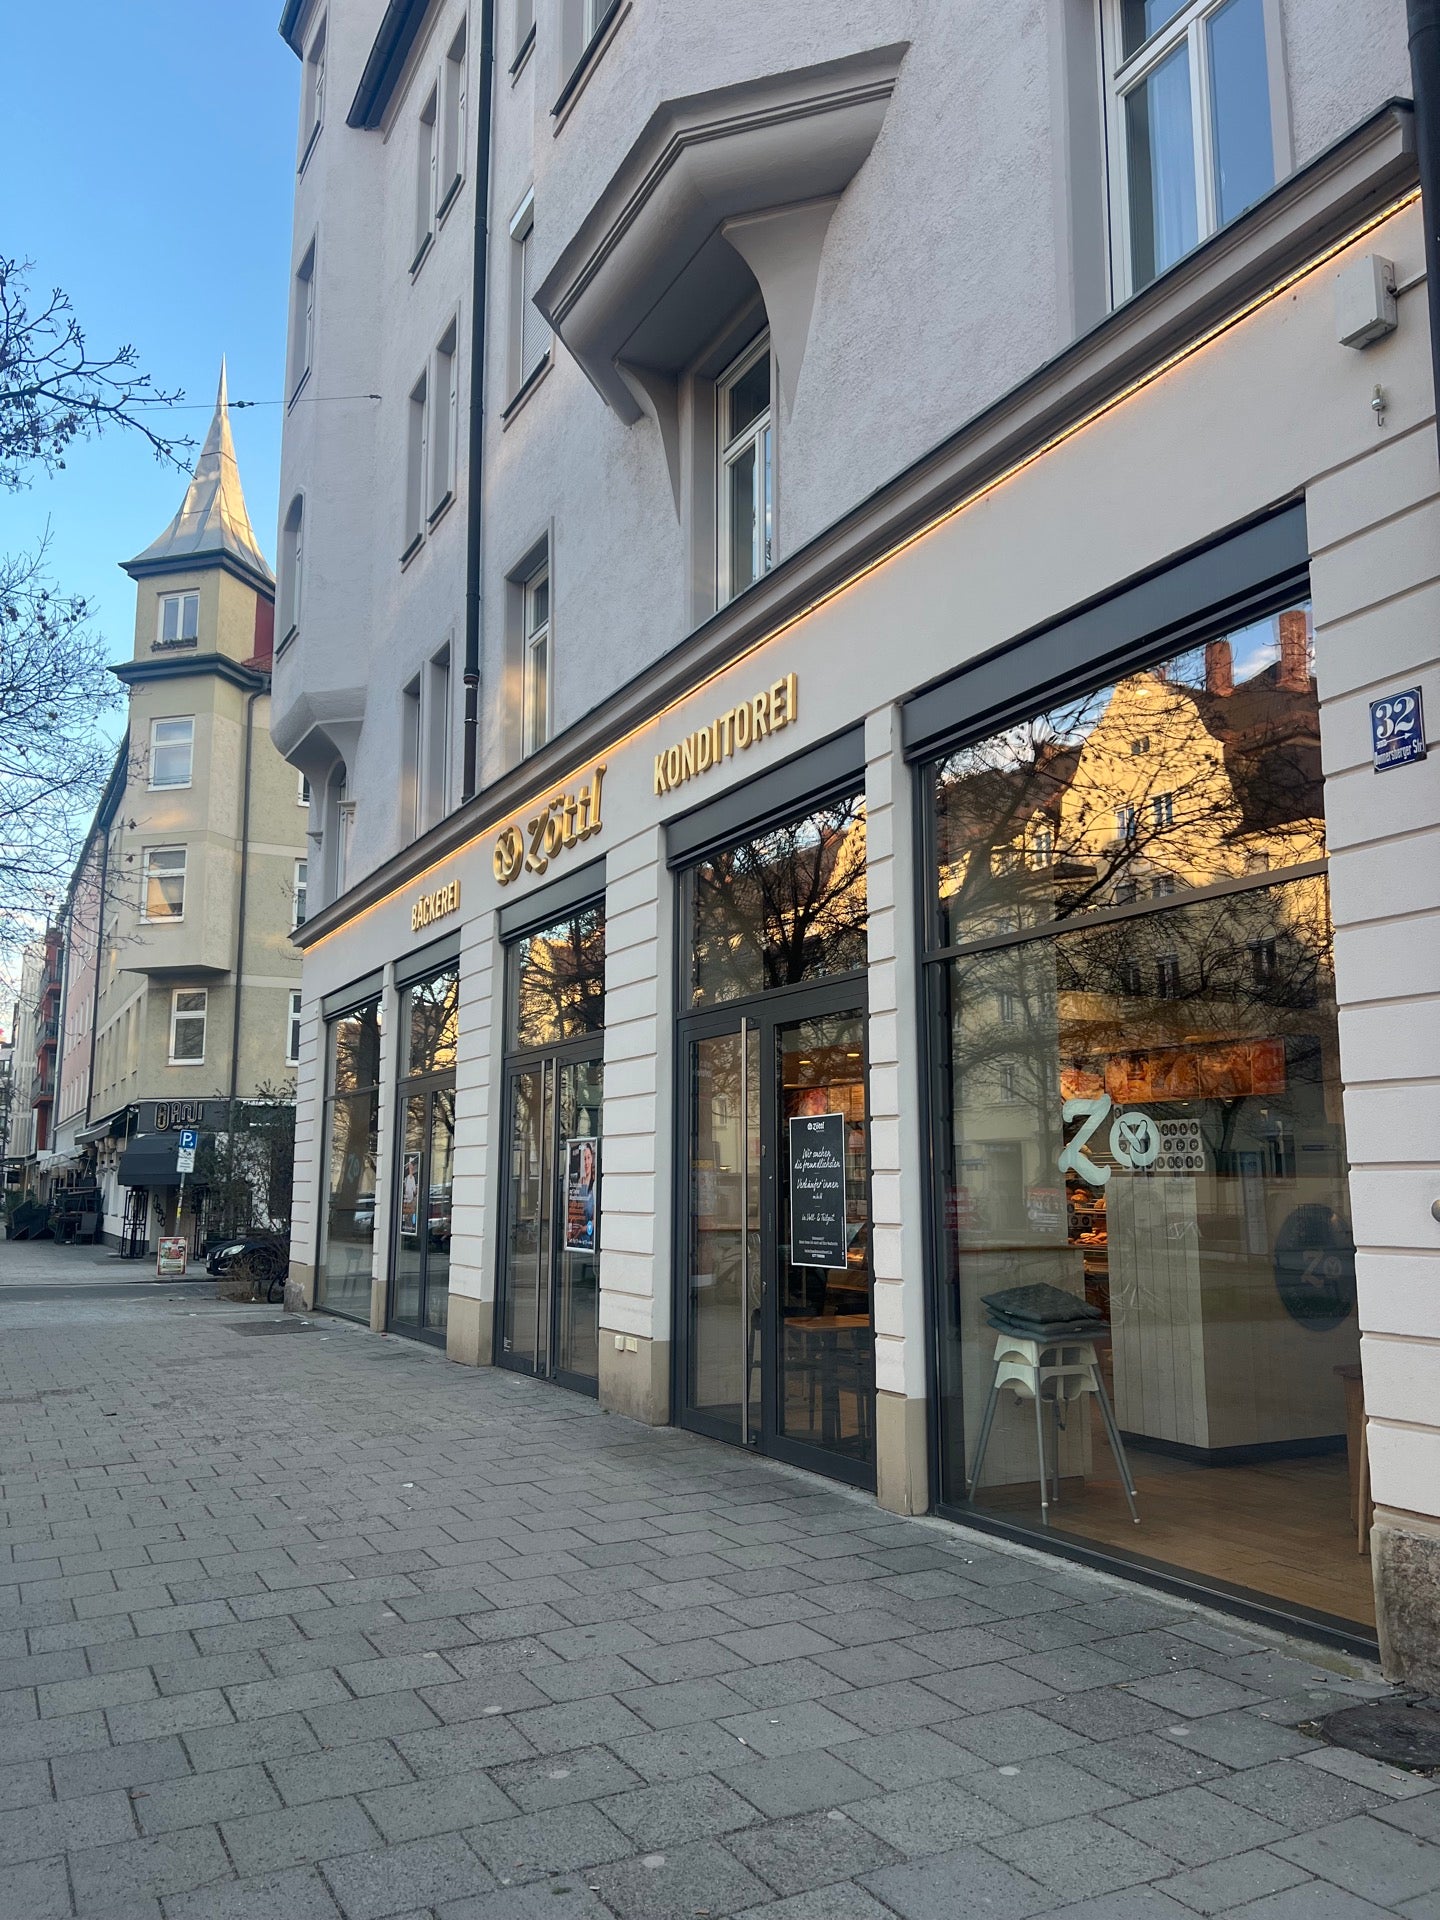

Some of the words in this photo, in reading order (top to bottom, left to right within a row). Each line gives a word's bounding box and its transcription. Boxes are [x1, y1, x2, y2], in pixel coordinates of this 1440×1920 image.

[654, 672, 798, 796] KONDITOREI
[1376, 696, 1415, 739] 32
[525, 764, 608, 876] Zöttl
[411, 879, 461, 932] BÄCKEREI
[182, 1132, 193, 1146] P
[802, 1147, 812, 1159] Wir
[813, 1146, 831, 1158] suchen
[794, 1159, 802, 1169] die
[802, 1157, 841, 1173] freundlichsten
